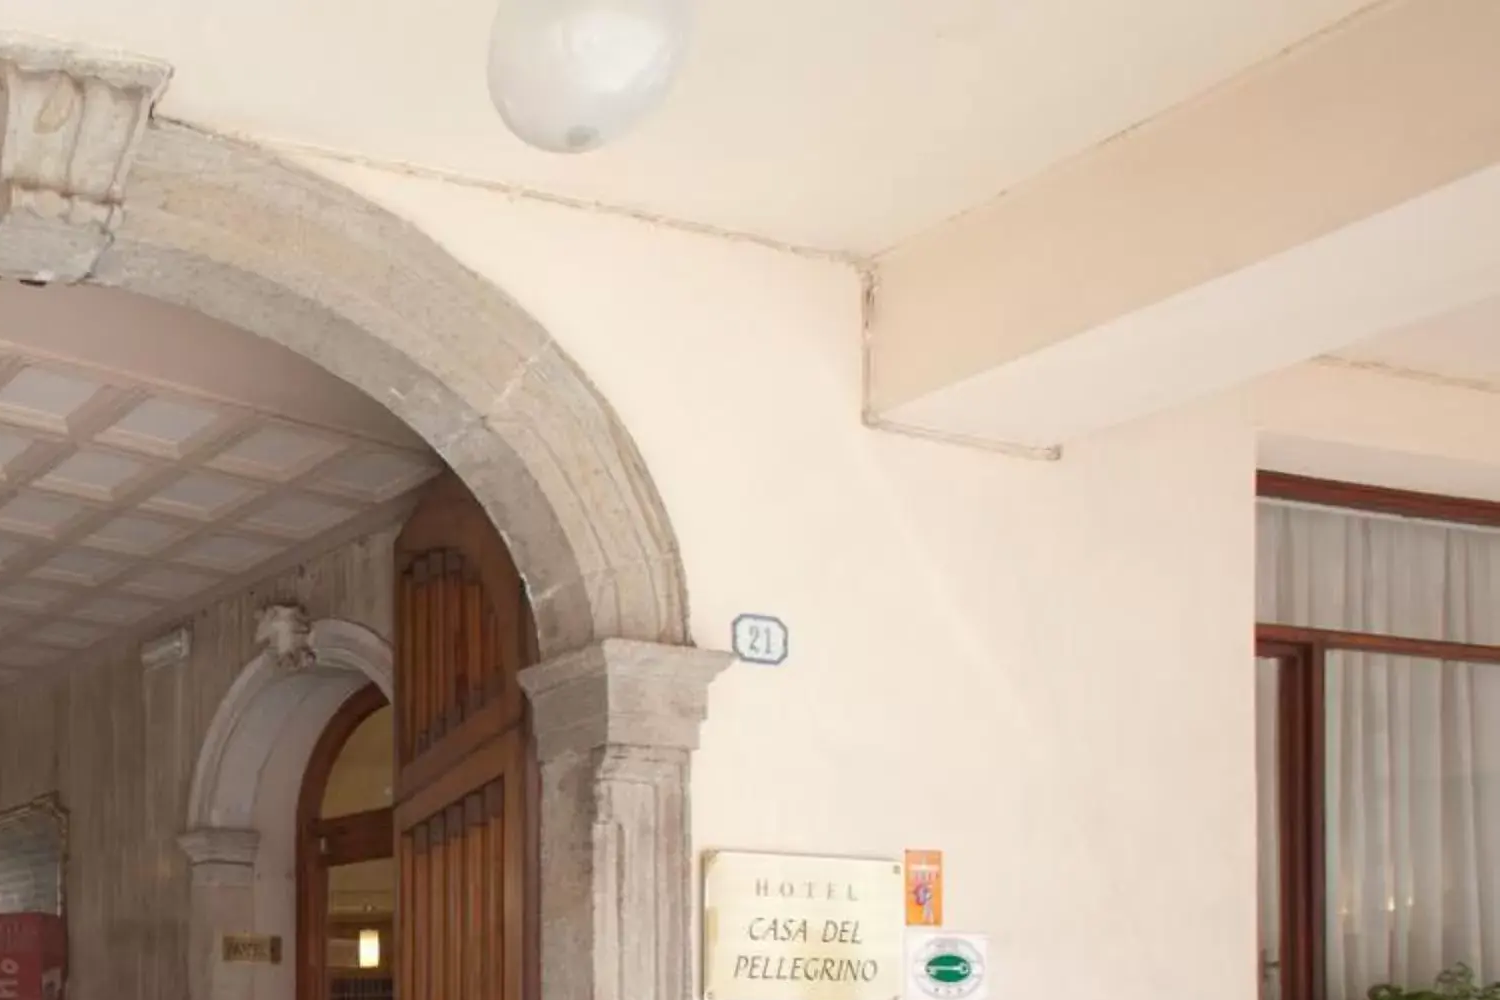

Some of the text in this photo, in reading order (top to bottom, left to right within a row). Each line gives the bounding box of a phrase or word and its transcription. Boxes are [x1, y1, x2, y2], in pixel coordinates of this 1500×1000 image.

[749, 625, 771, 654] 21
[754, 878, 860, 902] HOTEL
[749, 917, 863, 944] CASA DEL
[733, 954, 879, 982] PELLEGRINO
